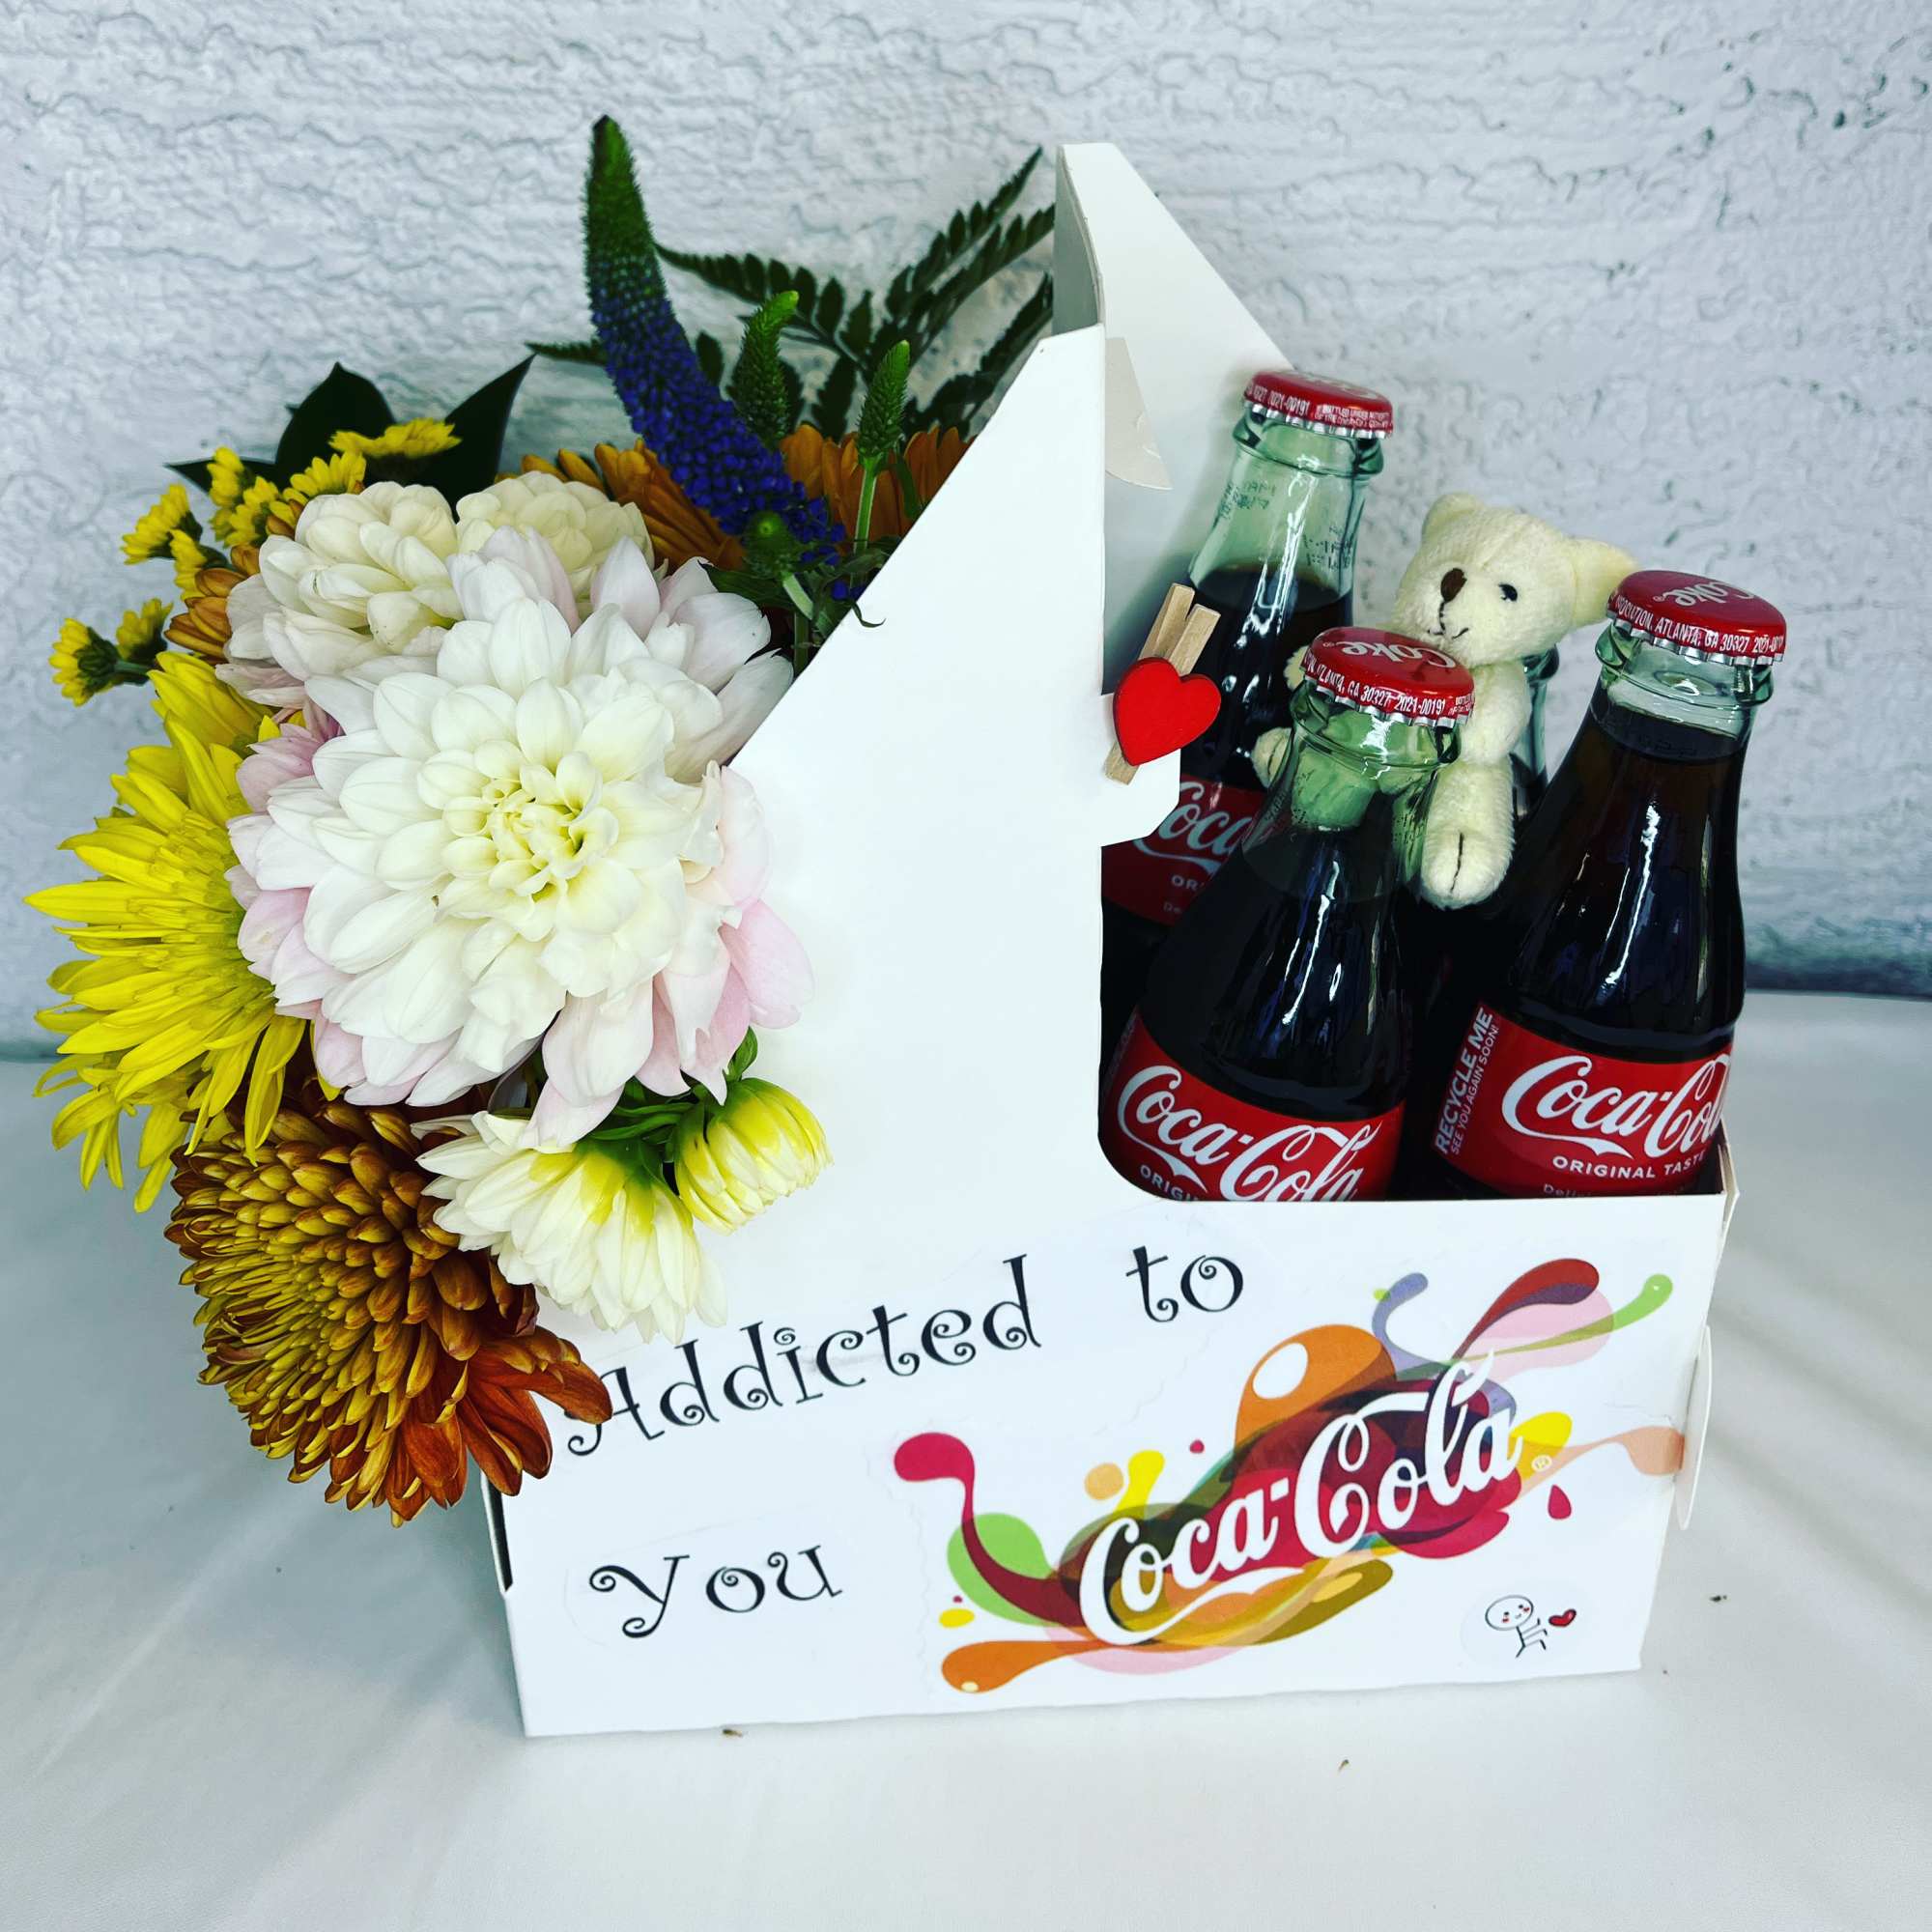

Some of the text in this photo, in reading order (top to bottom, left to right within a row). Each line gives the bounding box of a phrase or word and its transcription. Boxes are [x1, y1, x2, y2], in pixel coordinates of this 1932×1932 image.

[1337, 640, 1457, 668] Coke
[1719, 634, 1750, 653] 30327
[1360, 685, 1390, 708] 30327
[1394, 695, 1446, 716] 2021-00191
[1435, 1007, 1493, 1154] RECYCLE ME
[1451, 1130, 1463, 1155] SEE
[1458, 1104, 1472, 1130] YOU
[1465, 1065, 1485, 1105] AGAIN
[1551, 1154, 1657, 1179] ORIGINAL
[563, 1245, 1245, 1457] Addicted to
[1079, 1349, 1523, 1646] Coca-Cola
